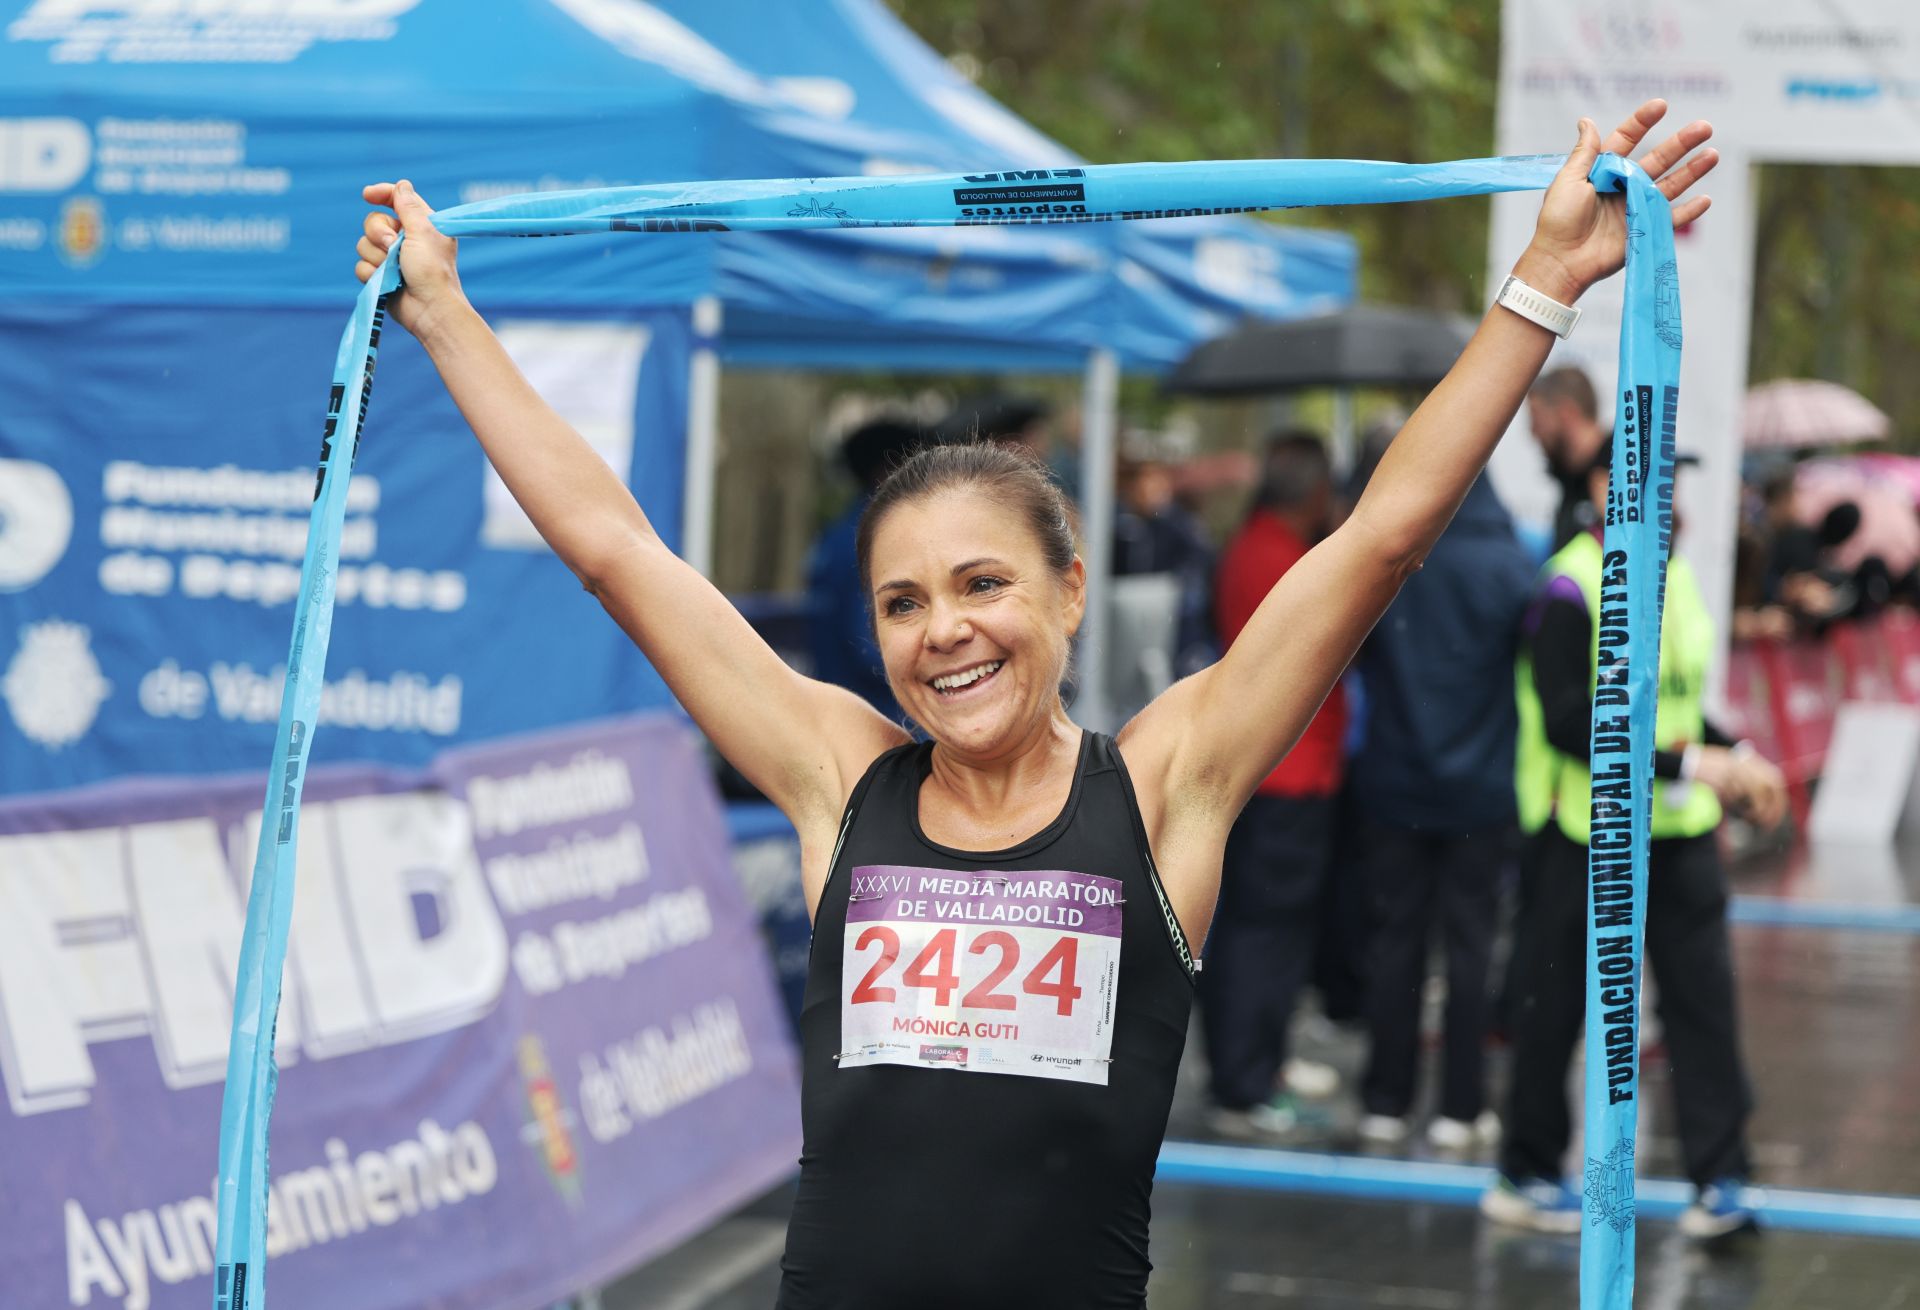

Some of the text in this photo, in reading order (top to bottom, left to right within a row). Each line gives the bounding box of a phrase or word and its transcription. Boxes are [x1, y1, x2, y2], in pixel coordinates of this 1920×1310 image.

[960, 192, 1006, 200] VALLADOLID
[1020, 189, 1078, 198] AYUNTAMIENTO
[961, 204, 1087, 216] Deportes
[1624, 389, 1640, 522] Deportes
[1590, 550, 1634, 1105] FUNDACION MUNICIPAL DE DEPORTES
[855, 876, 1115, 908] XXXVI MEDIA MARATÓN
[897, 900, 1084, 927] DE VALLADOLID
[851, 925, 1082, 1016] 2424
[892, 1015, 1019, 1041] MÓNICA GUTI
[64, 1119, 496, 1310] Ayunamiento
